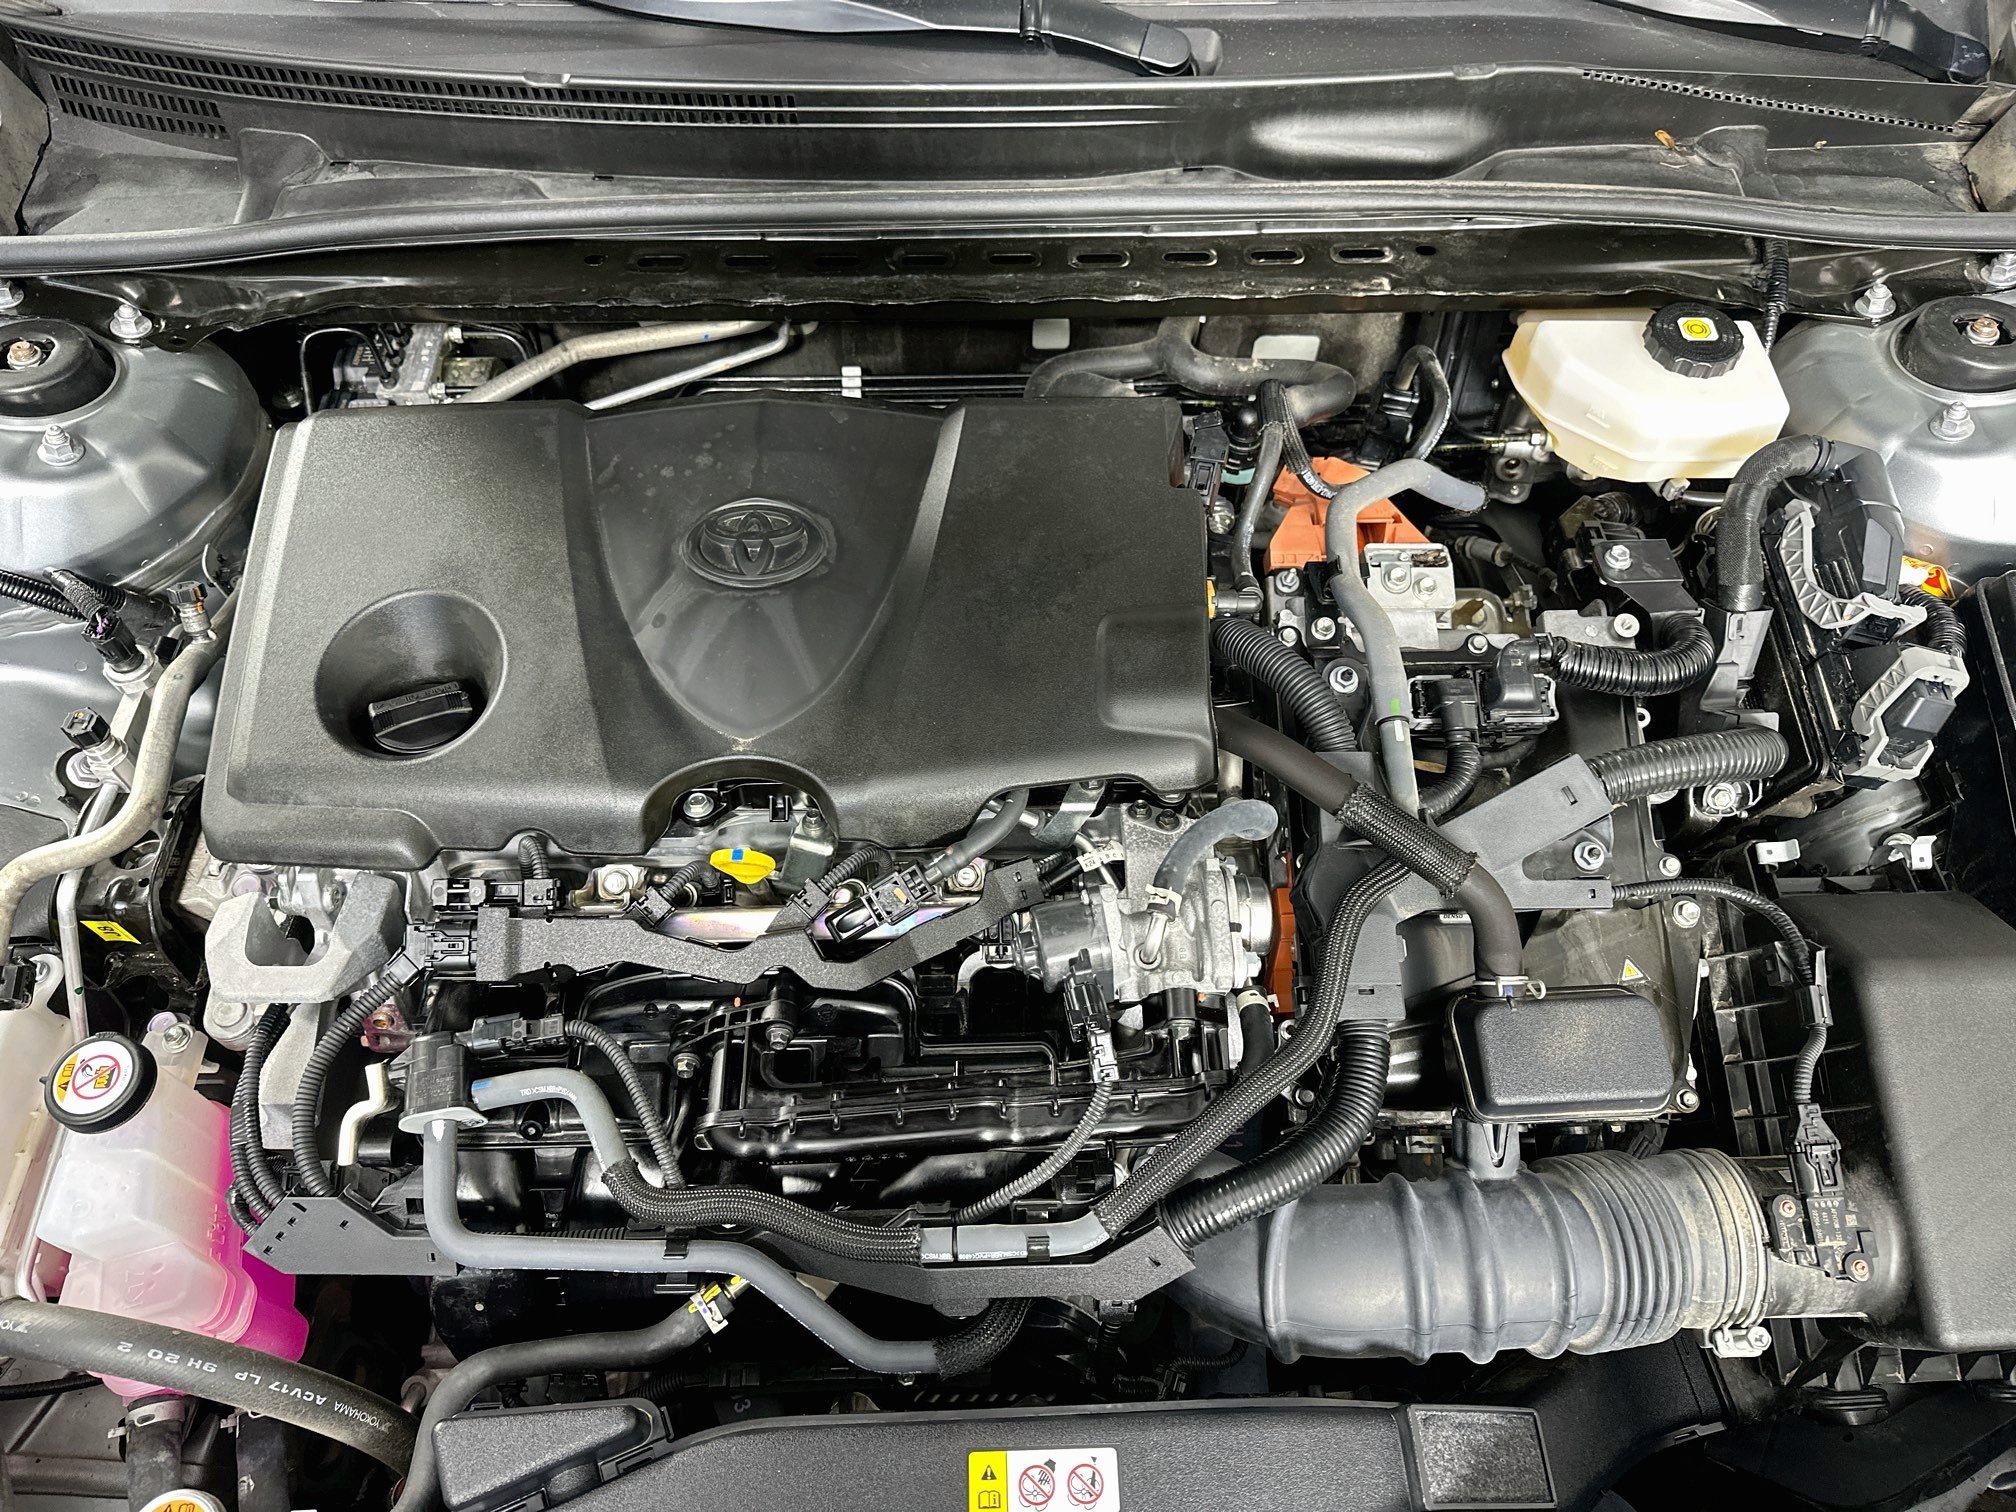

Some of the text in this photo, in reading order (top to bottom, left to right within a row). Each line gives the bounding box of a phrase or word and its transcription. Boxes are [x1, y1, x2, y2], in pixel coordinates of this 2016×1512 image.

[116, 1341, 134, 1353] 2
[186, 1357, 218, 1373] 9H
[235, 1371, 262, 1385] LP
[268, 1381, 328, 1406] ACV17
[334, 1401, 382, 1428] YOKOHAMA
